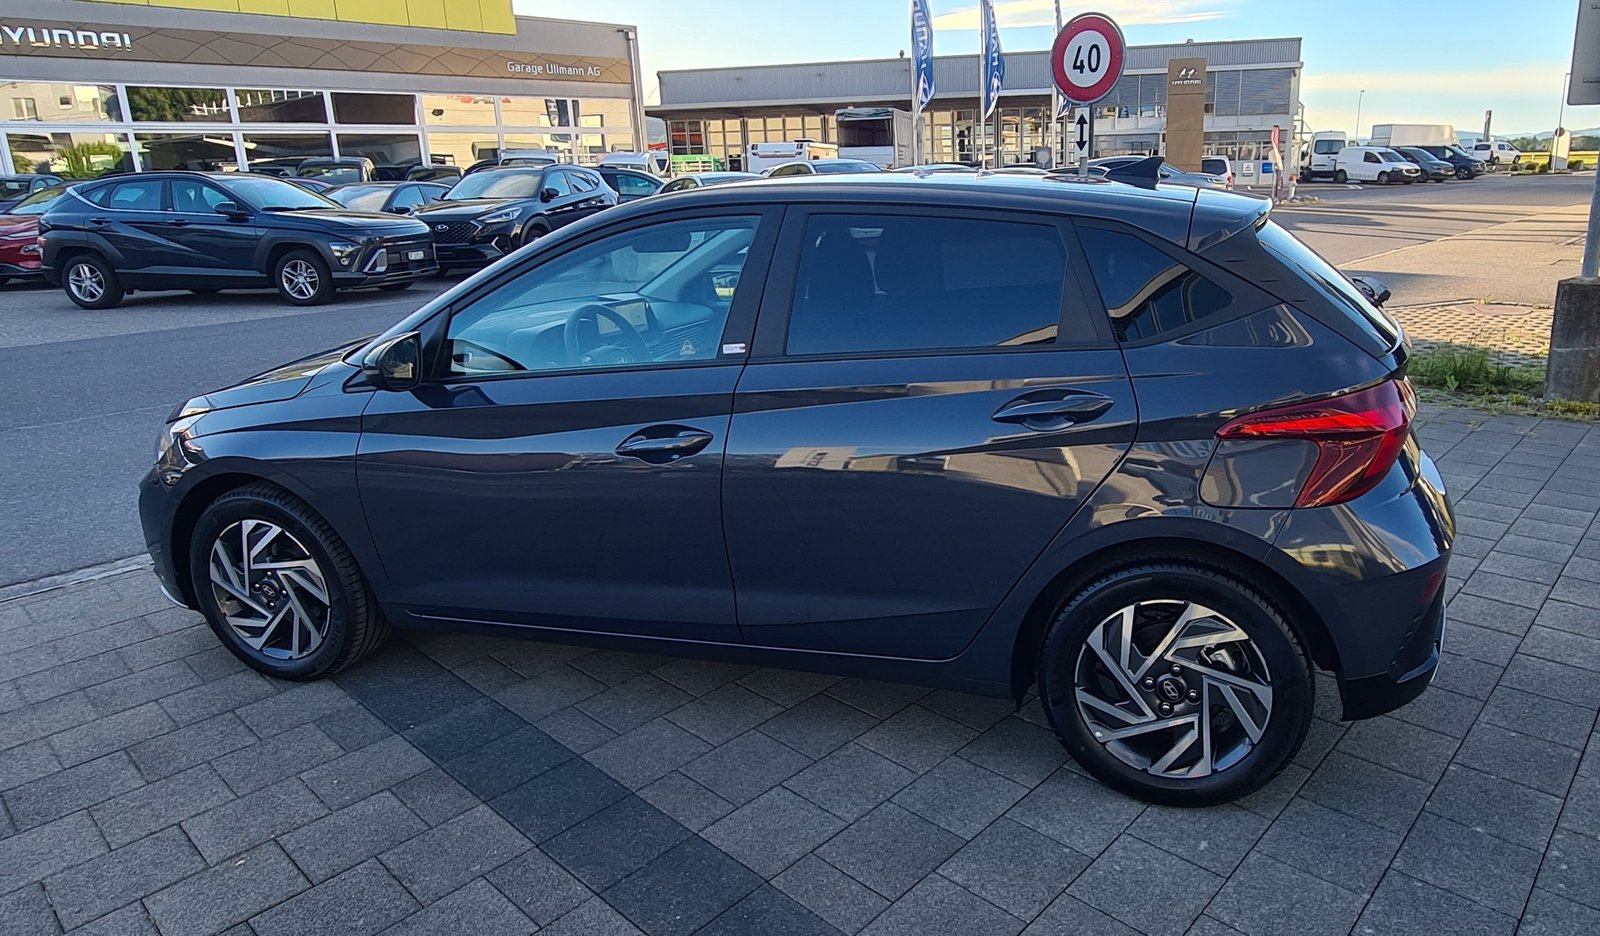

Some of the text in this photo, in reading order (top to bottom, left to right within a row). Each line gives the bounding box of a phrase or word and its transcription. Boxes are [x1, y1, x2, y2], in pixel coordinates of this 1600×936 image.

[0, 25, 133, 52] YUNDAI
[507, 61, 601, 77] Garage Ullmann AG
[1072, 43, 1101, 74] 40
